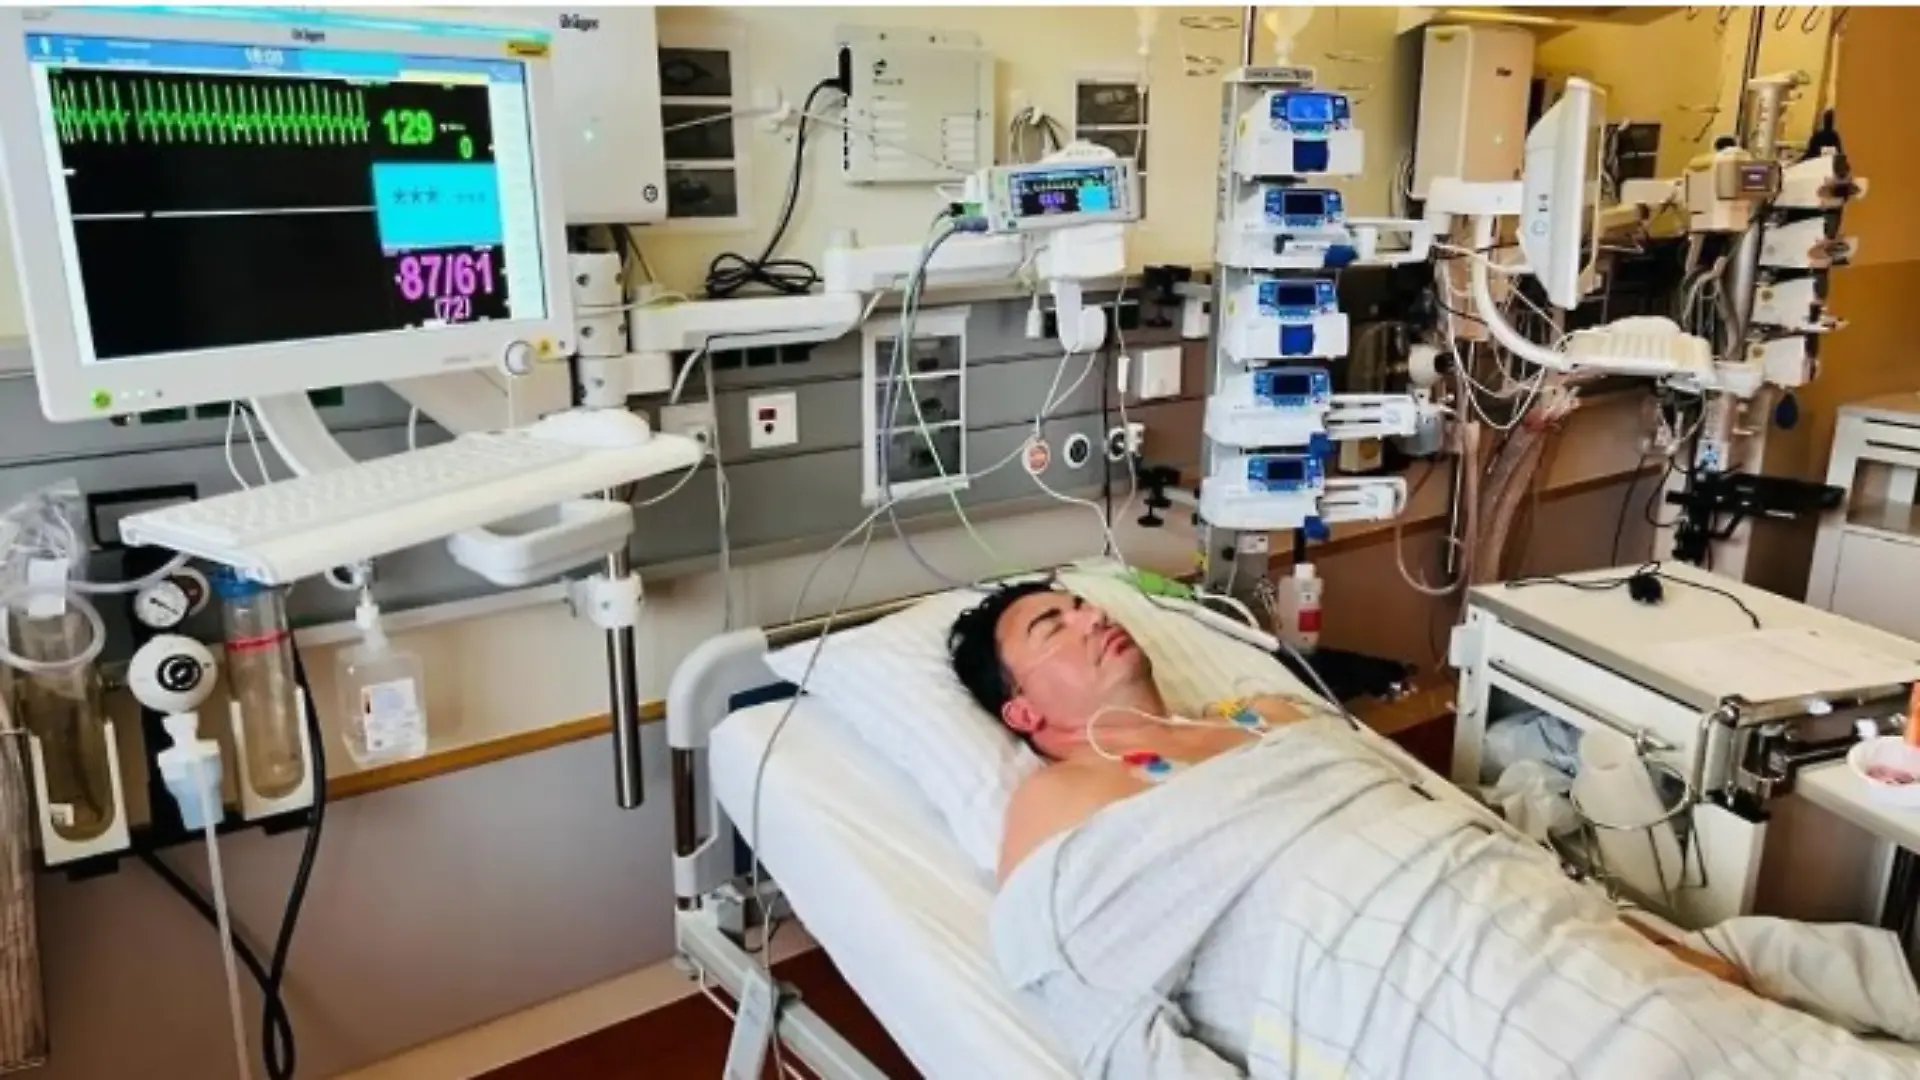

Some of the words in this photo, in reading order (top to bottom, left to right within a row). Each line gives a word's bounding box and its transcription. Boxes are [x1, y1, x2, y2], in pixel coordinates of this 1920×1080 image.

[382, 108, 433, 145] 129
[459, 135, 473, 159] 0
[400, 252, 493, 300] 87/61
